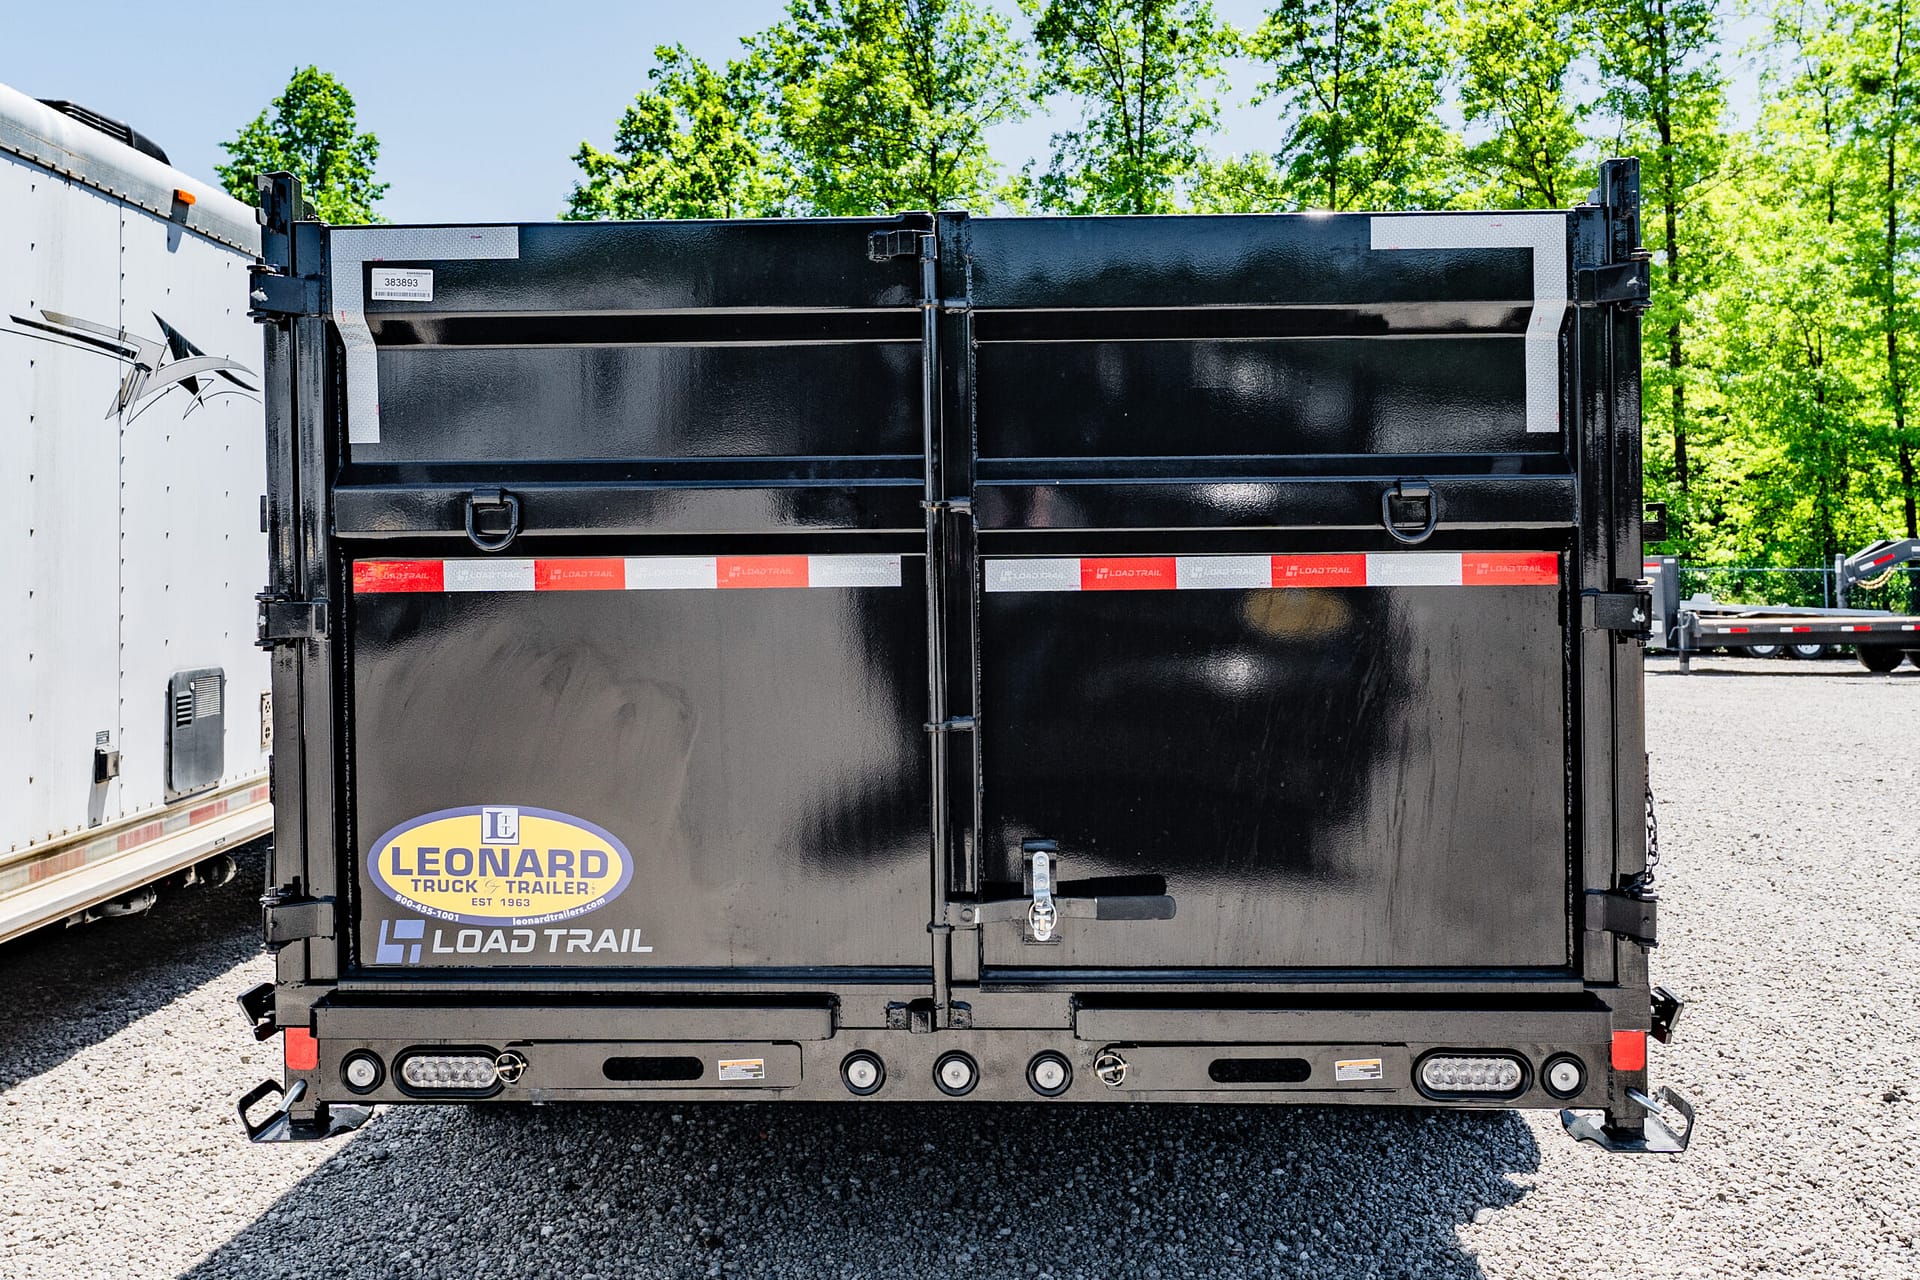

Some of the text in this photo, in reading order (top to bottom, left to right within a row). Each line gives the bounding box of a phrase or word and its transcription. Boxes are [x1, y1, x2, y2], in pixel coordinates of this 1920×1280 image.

[384, 277, 418, 287] 383893
[741, 567, 795, 576] LOAD TRAIL
[1110, 568, 1163, 577] LOAD TRAIL
[1299, 566, 1353, 575] LOAD TRAIL
[1489, 565, 1544, 573] LOAD TRAIL
[378, 572, 402, 580] OAD
[563, 570, 615, 578] LOAD TRAIL
[391, 846, 609, 879] LEONARD
[411, 878, 478, 893] TRUCK
[505, 880, 589, 895] TRAILER
[471, 898, 530, 907] EST 1963
[394, 894, 460, 922] 800-455-1001
[512, 897, 606, 926] leonardtrailers.com
[432, 928, 654, 954] LOAD TRAIL
